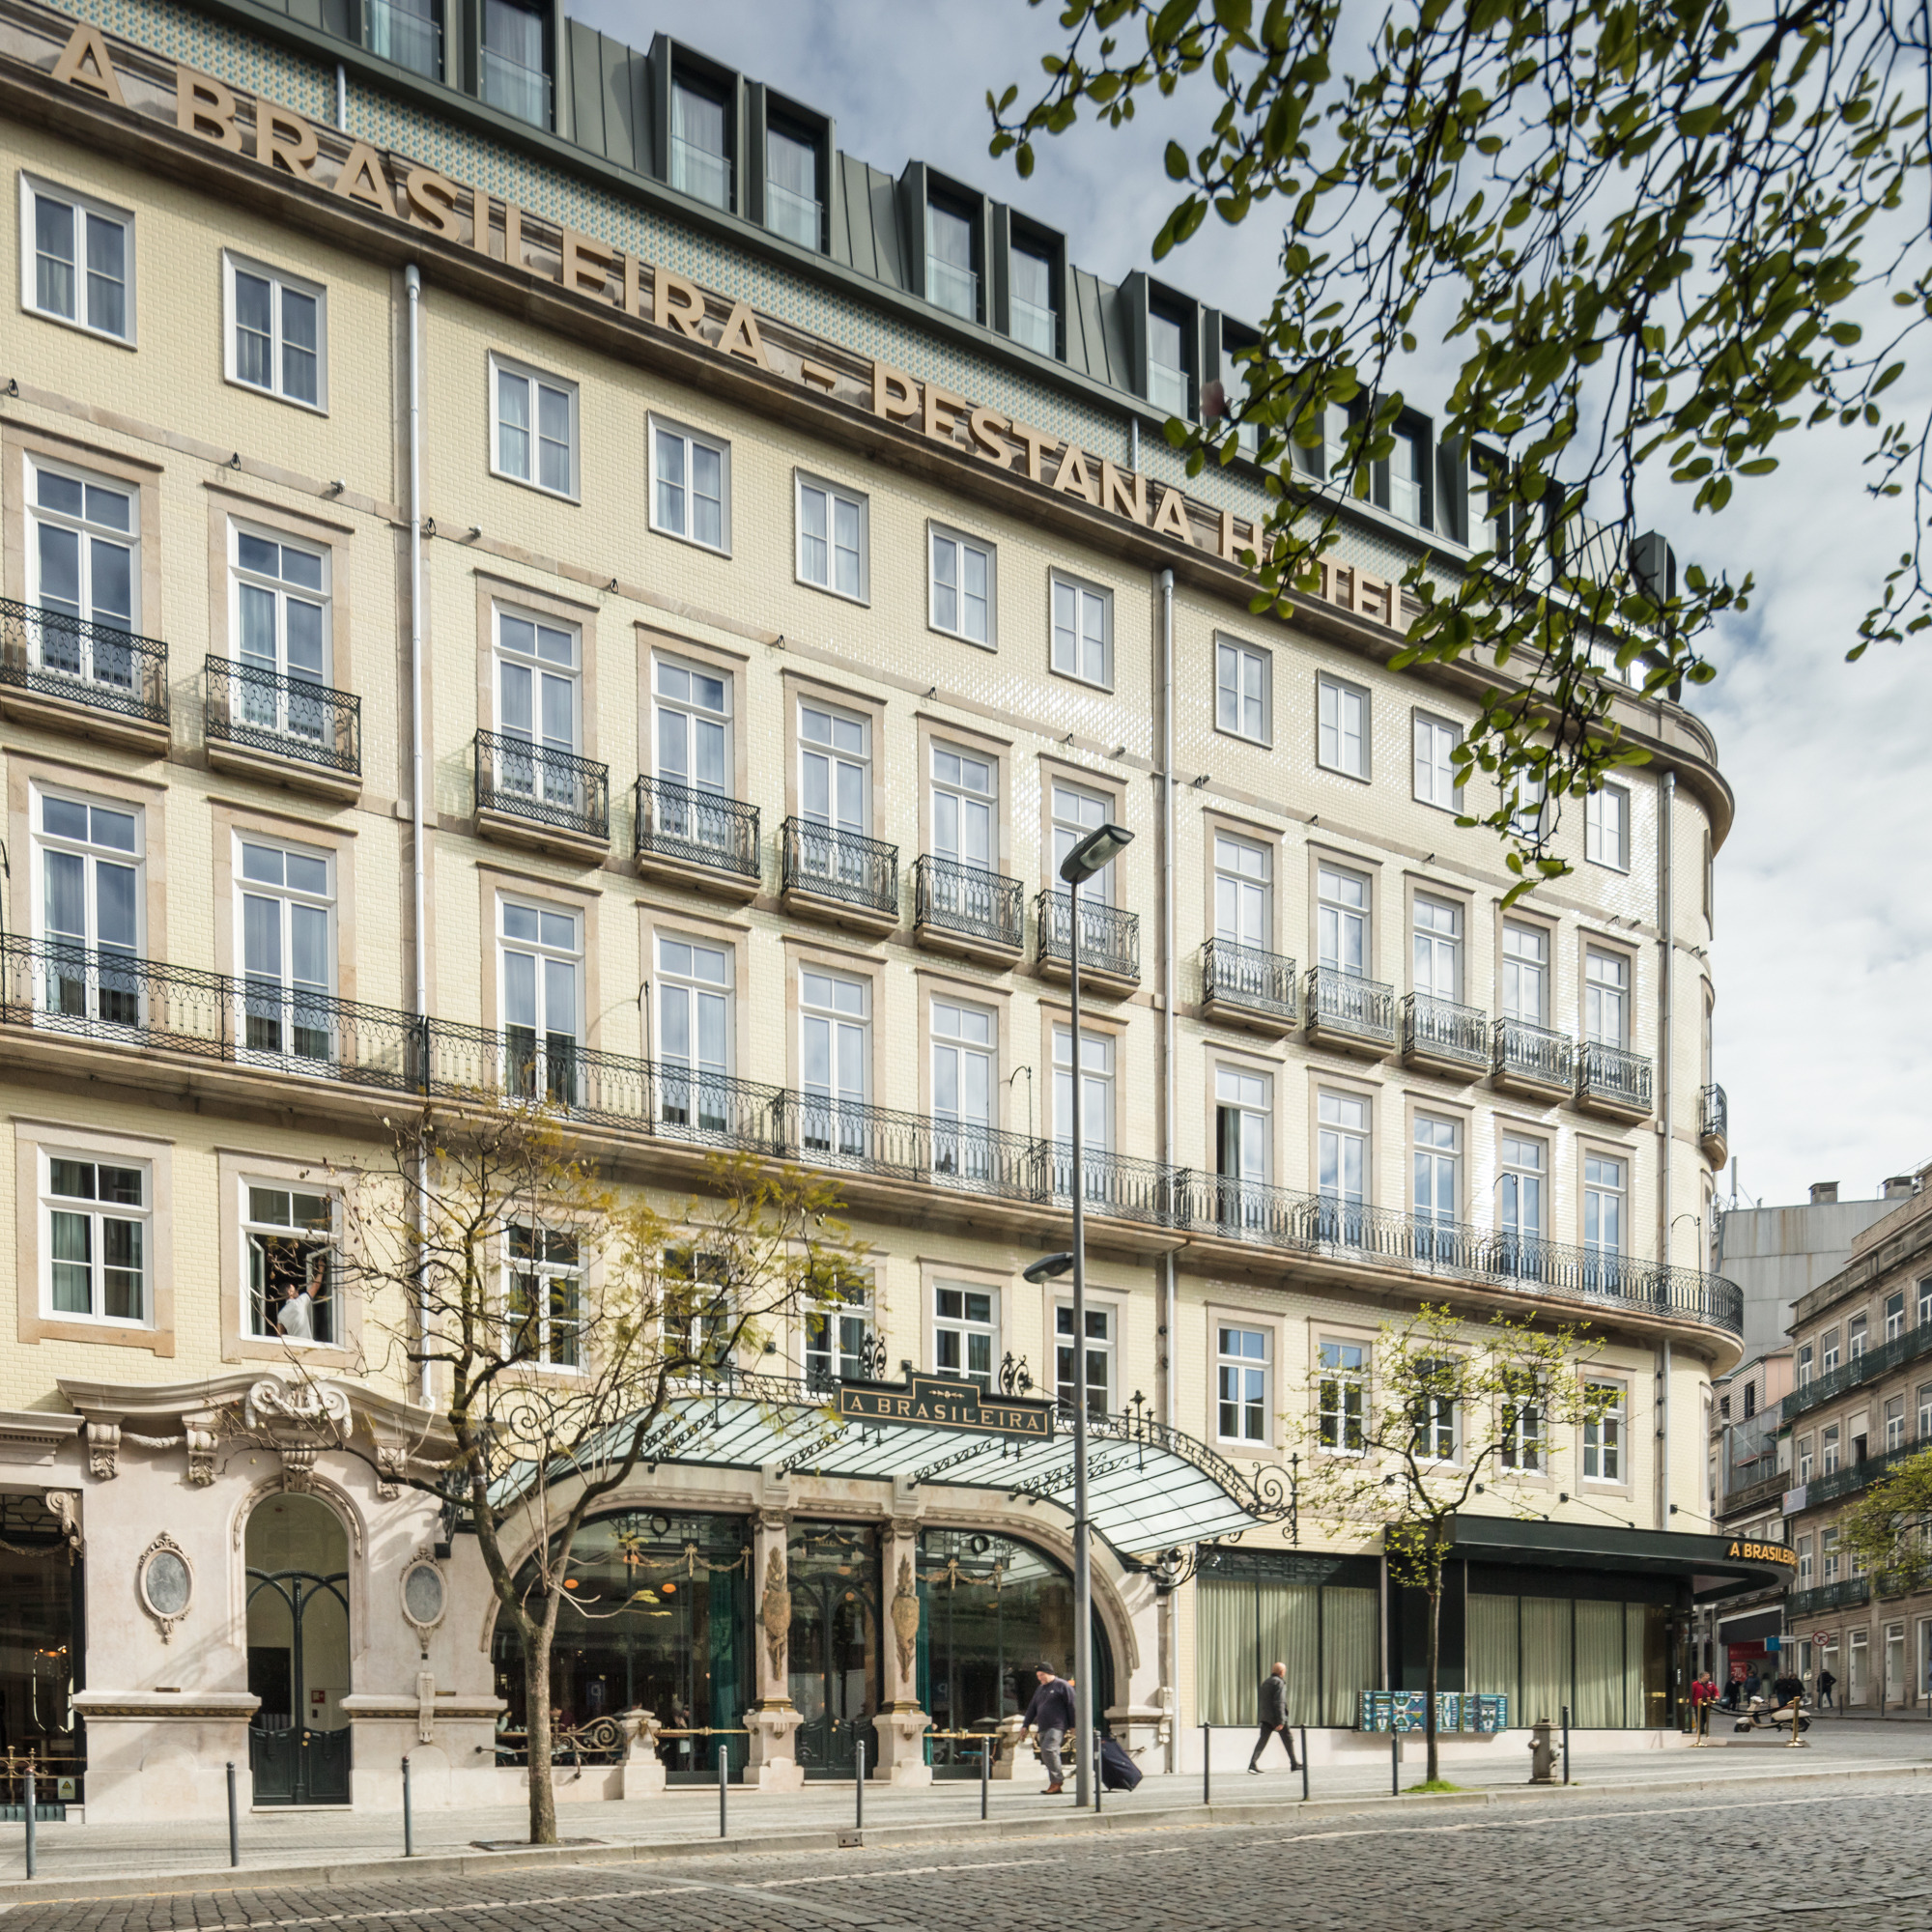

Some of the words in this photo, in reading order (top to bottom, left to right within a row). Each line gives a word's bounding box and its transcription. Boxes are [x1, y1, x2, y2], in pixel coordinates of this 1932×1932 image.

[50, 21, 128, 106] A
[176, 63, 773, 371] BRASILEIRA
[871, 361, 1196, 547] PESTANA
[1218, 510, 1408, 636] HTEL
[850, 1395, 864, 1411] A
[877, 1398, 1039, 1430] BRASILEIRA
[1729, 1542, 1740, 1557] A
